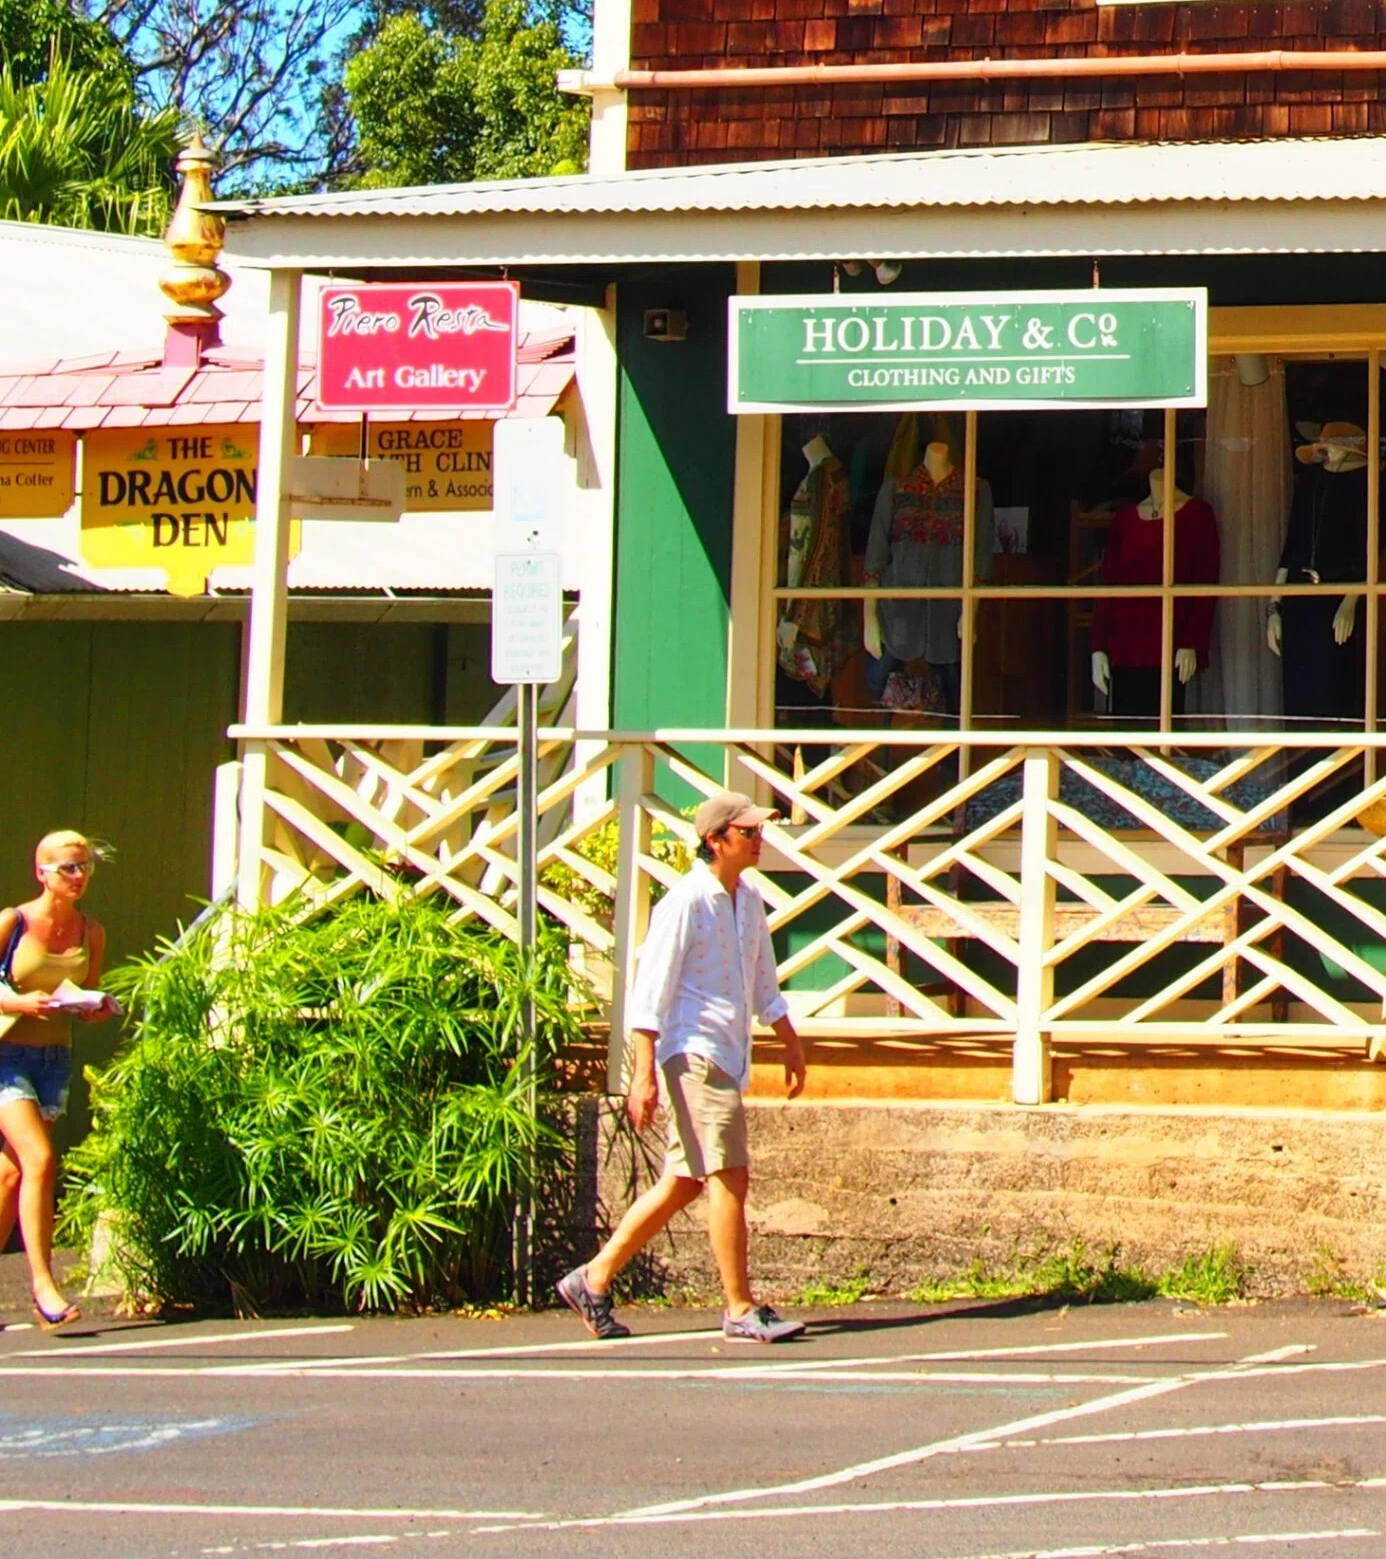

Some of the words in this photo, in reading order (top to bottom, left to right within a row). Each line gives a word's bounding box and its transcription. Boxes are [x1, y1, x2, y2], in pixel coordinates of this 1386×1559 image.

[329, 295, 400, 335] Piero
[408, 293, 510, 338] Resta
[802, 315, 1013, 353] HOLIDAY
[1022, 318, 1053, 349] &
[344, 367, 385, 388] Art
[394, 363, 486, 392] Gallery
[848, 368, 960, 387] CLOTHING
[965, 367, 1012, 384] AND
[1015, 366, 1076, 384] GIFTS
[14, 438, 55, 454] CENTER
[166, 436, 213, 460] THE
[378, 429, 463, 450] GRACE
[98, 468, 257, 507] DRAGON
[428, 479, 438, 498] &
[151, 512, 229, 548] DEN
